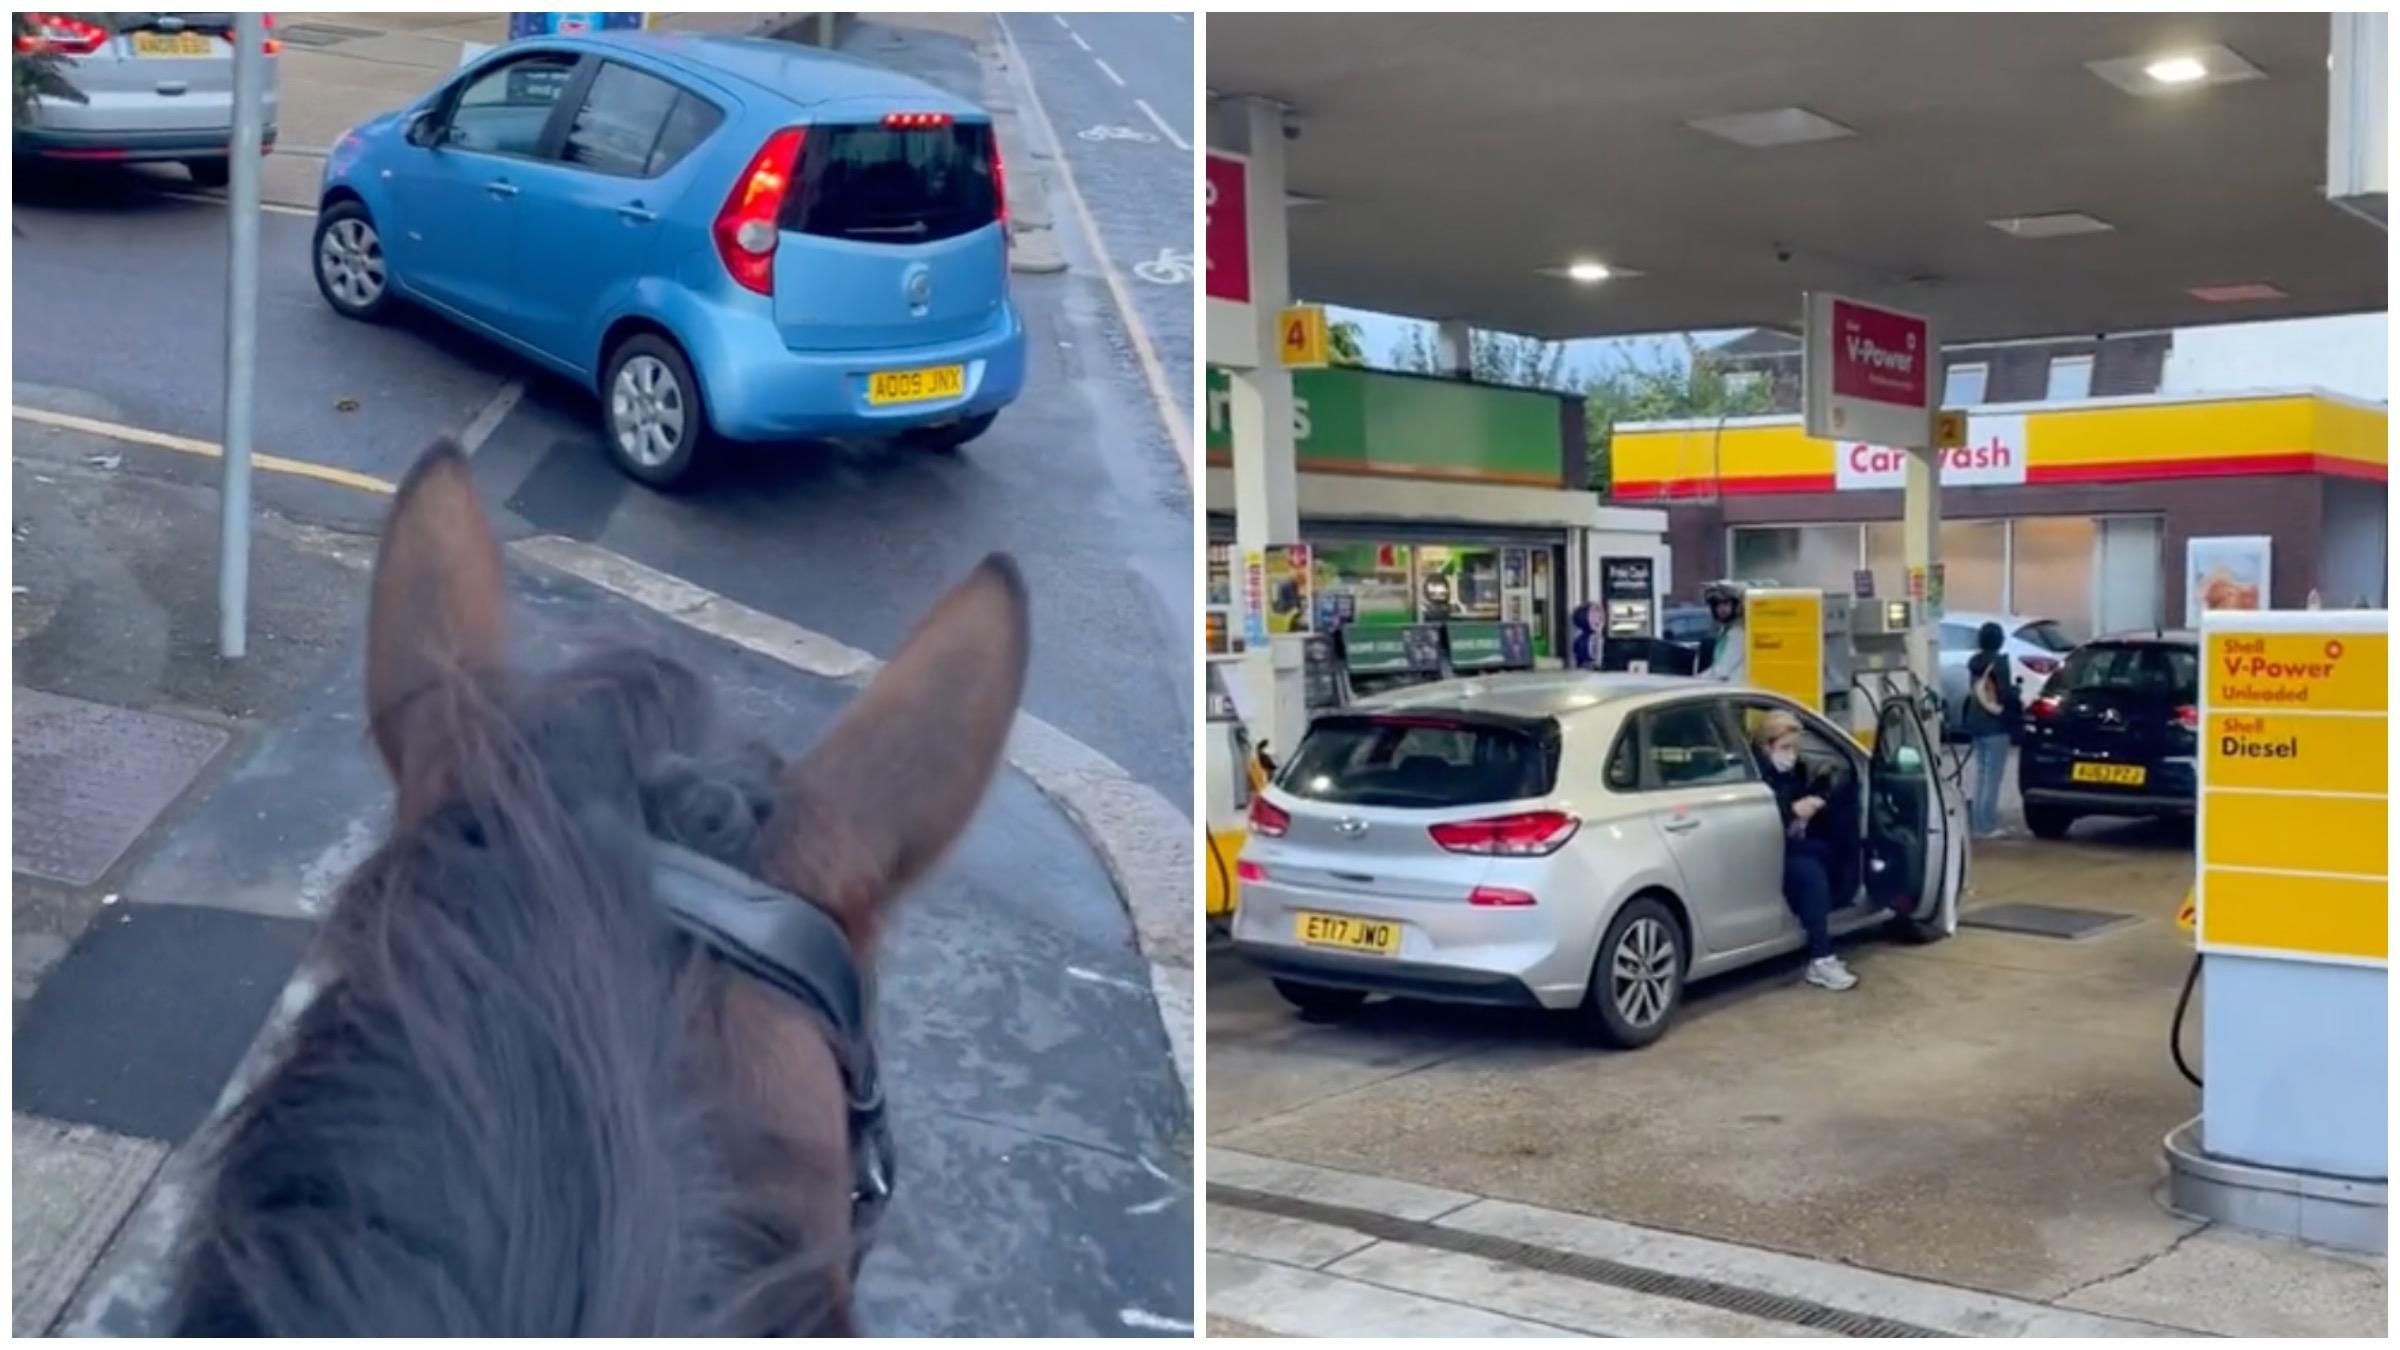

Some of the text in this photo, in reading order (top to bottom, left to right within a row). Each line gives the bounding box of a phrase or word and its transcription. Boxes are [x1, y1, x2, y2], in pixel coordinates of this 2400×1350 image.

[1287, 320, 1305, 350] 4
[1846, 336, 1914, 373] V-Power
[1849, 444, 1906, 473] Car
[2223, 638, 2264, 655] Shell
[2223, 656, 2334, 678] V-Power
[2222, 685, 2309, 703] Unleaded
[2223, 717, 2264, 734] Shell
[2221, 735, 2298, 758] Diesel
[1307, 915, 1348, 941] ET17
